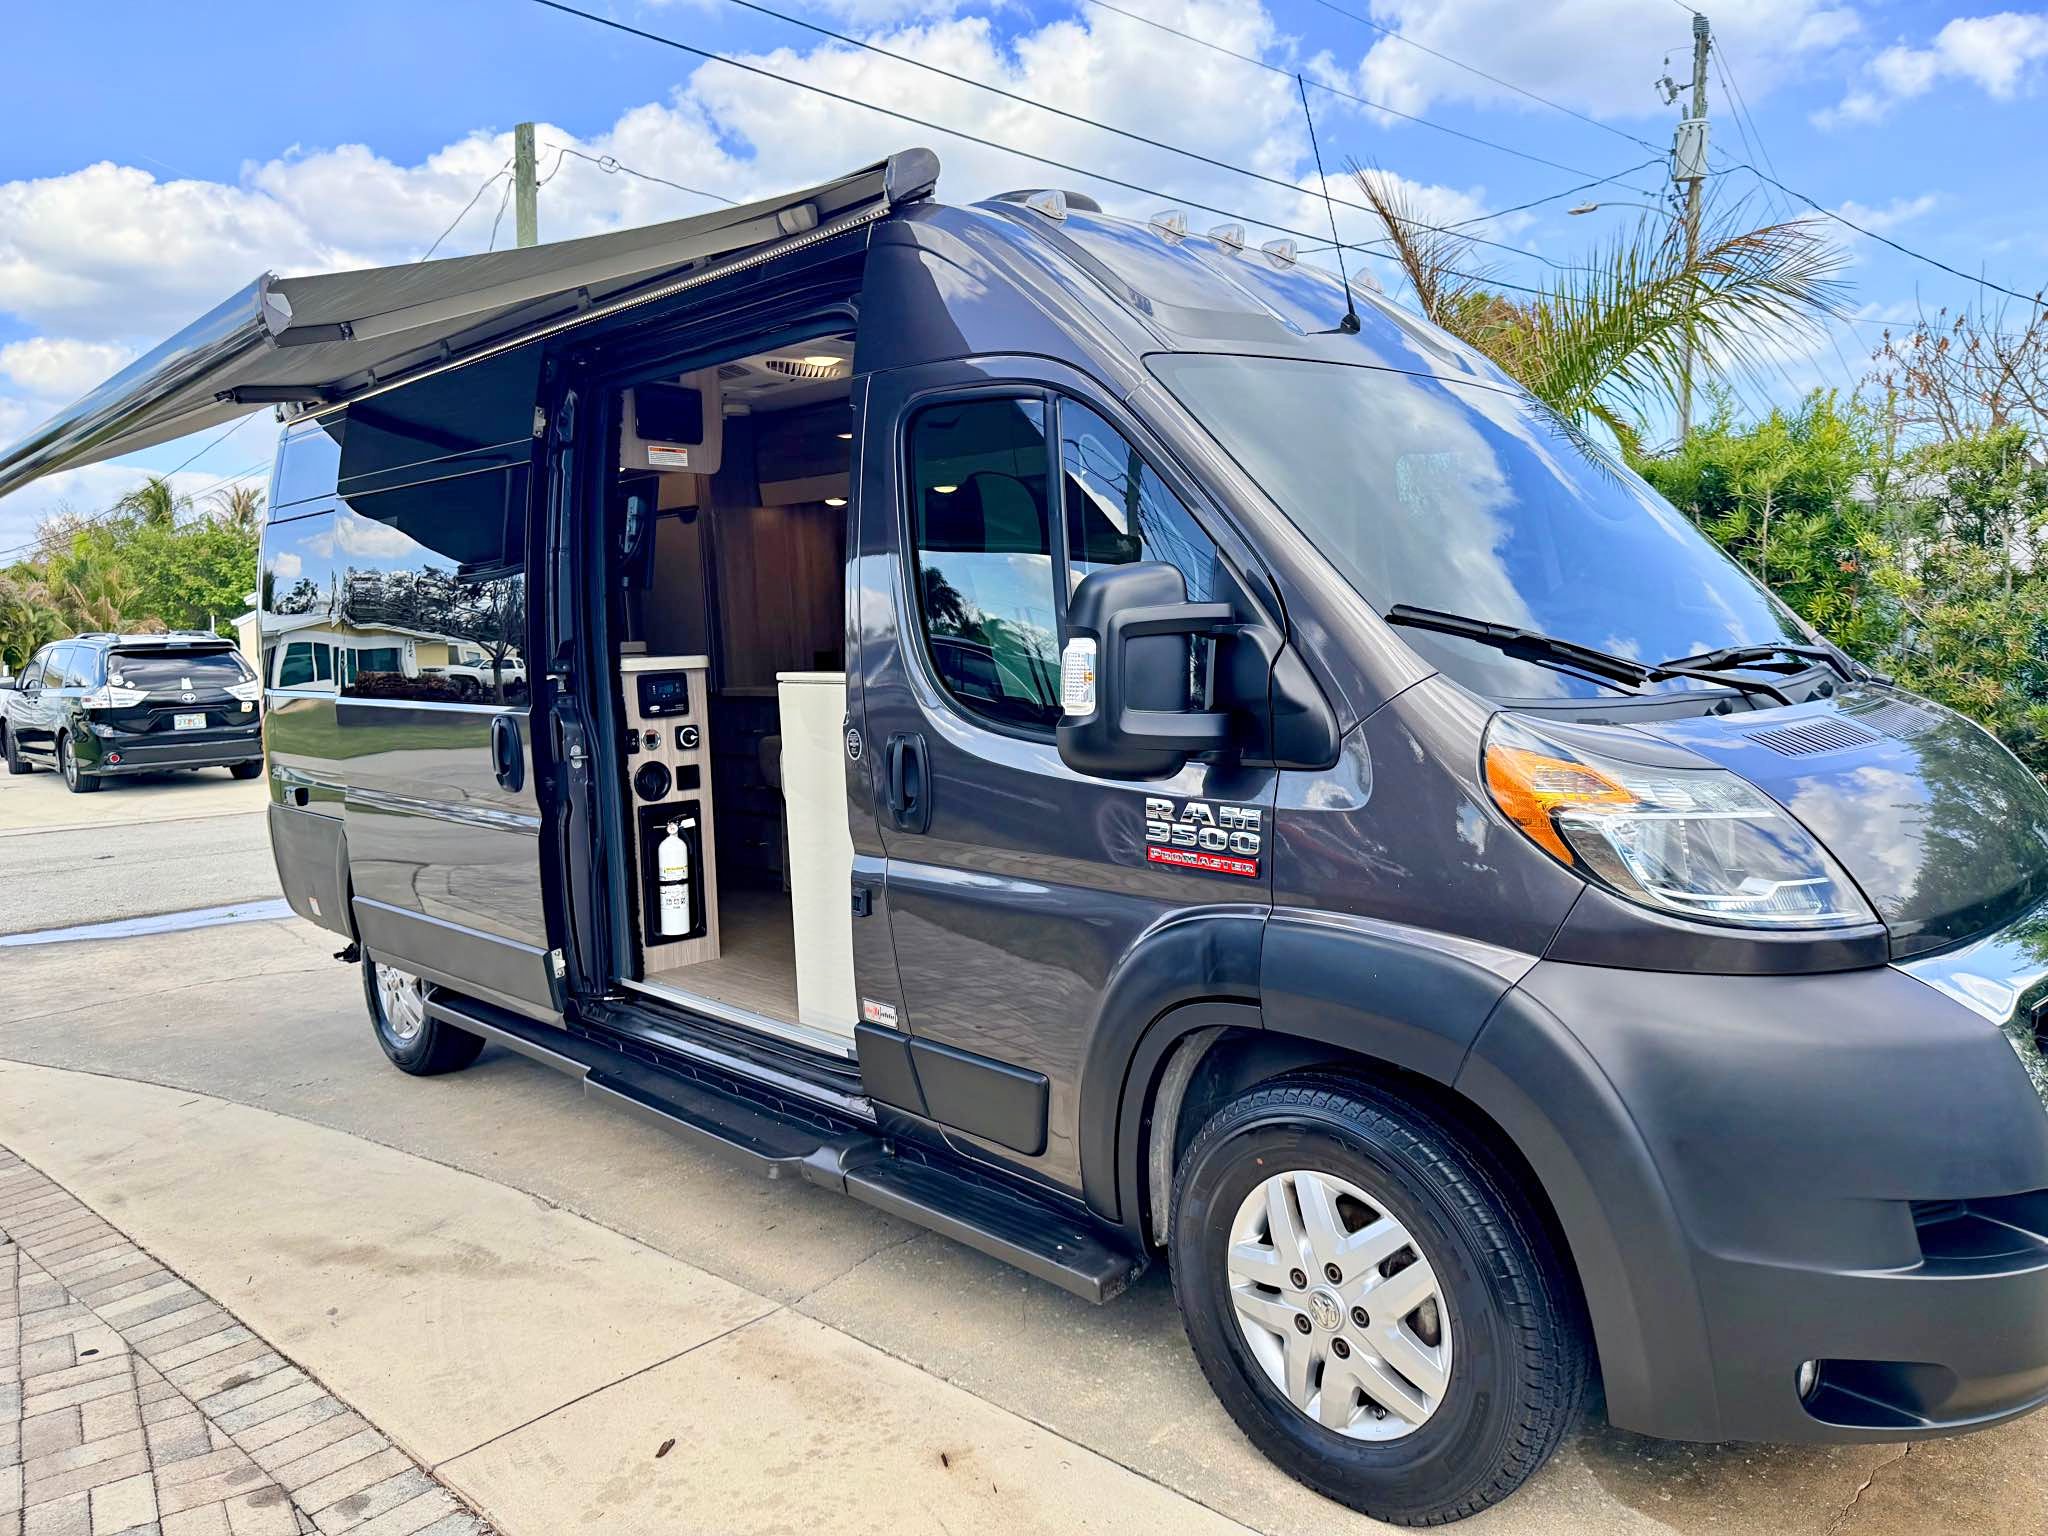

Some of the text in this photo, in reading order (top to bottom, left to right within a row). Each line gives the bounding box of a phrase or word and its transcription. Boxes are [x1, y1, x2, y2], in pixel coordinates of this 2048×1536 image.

[1145, 797, 1263, 831] RAM
[1145, 820, 1262, 855] 3500
[1149, 847, 1255, 873] PROMASTER
